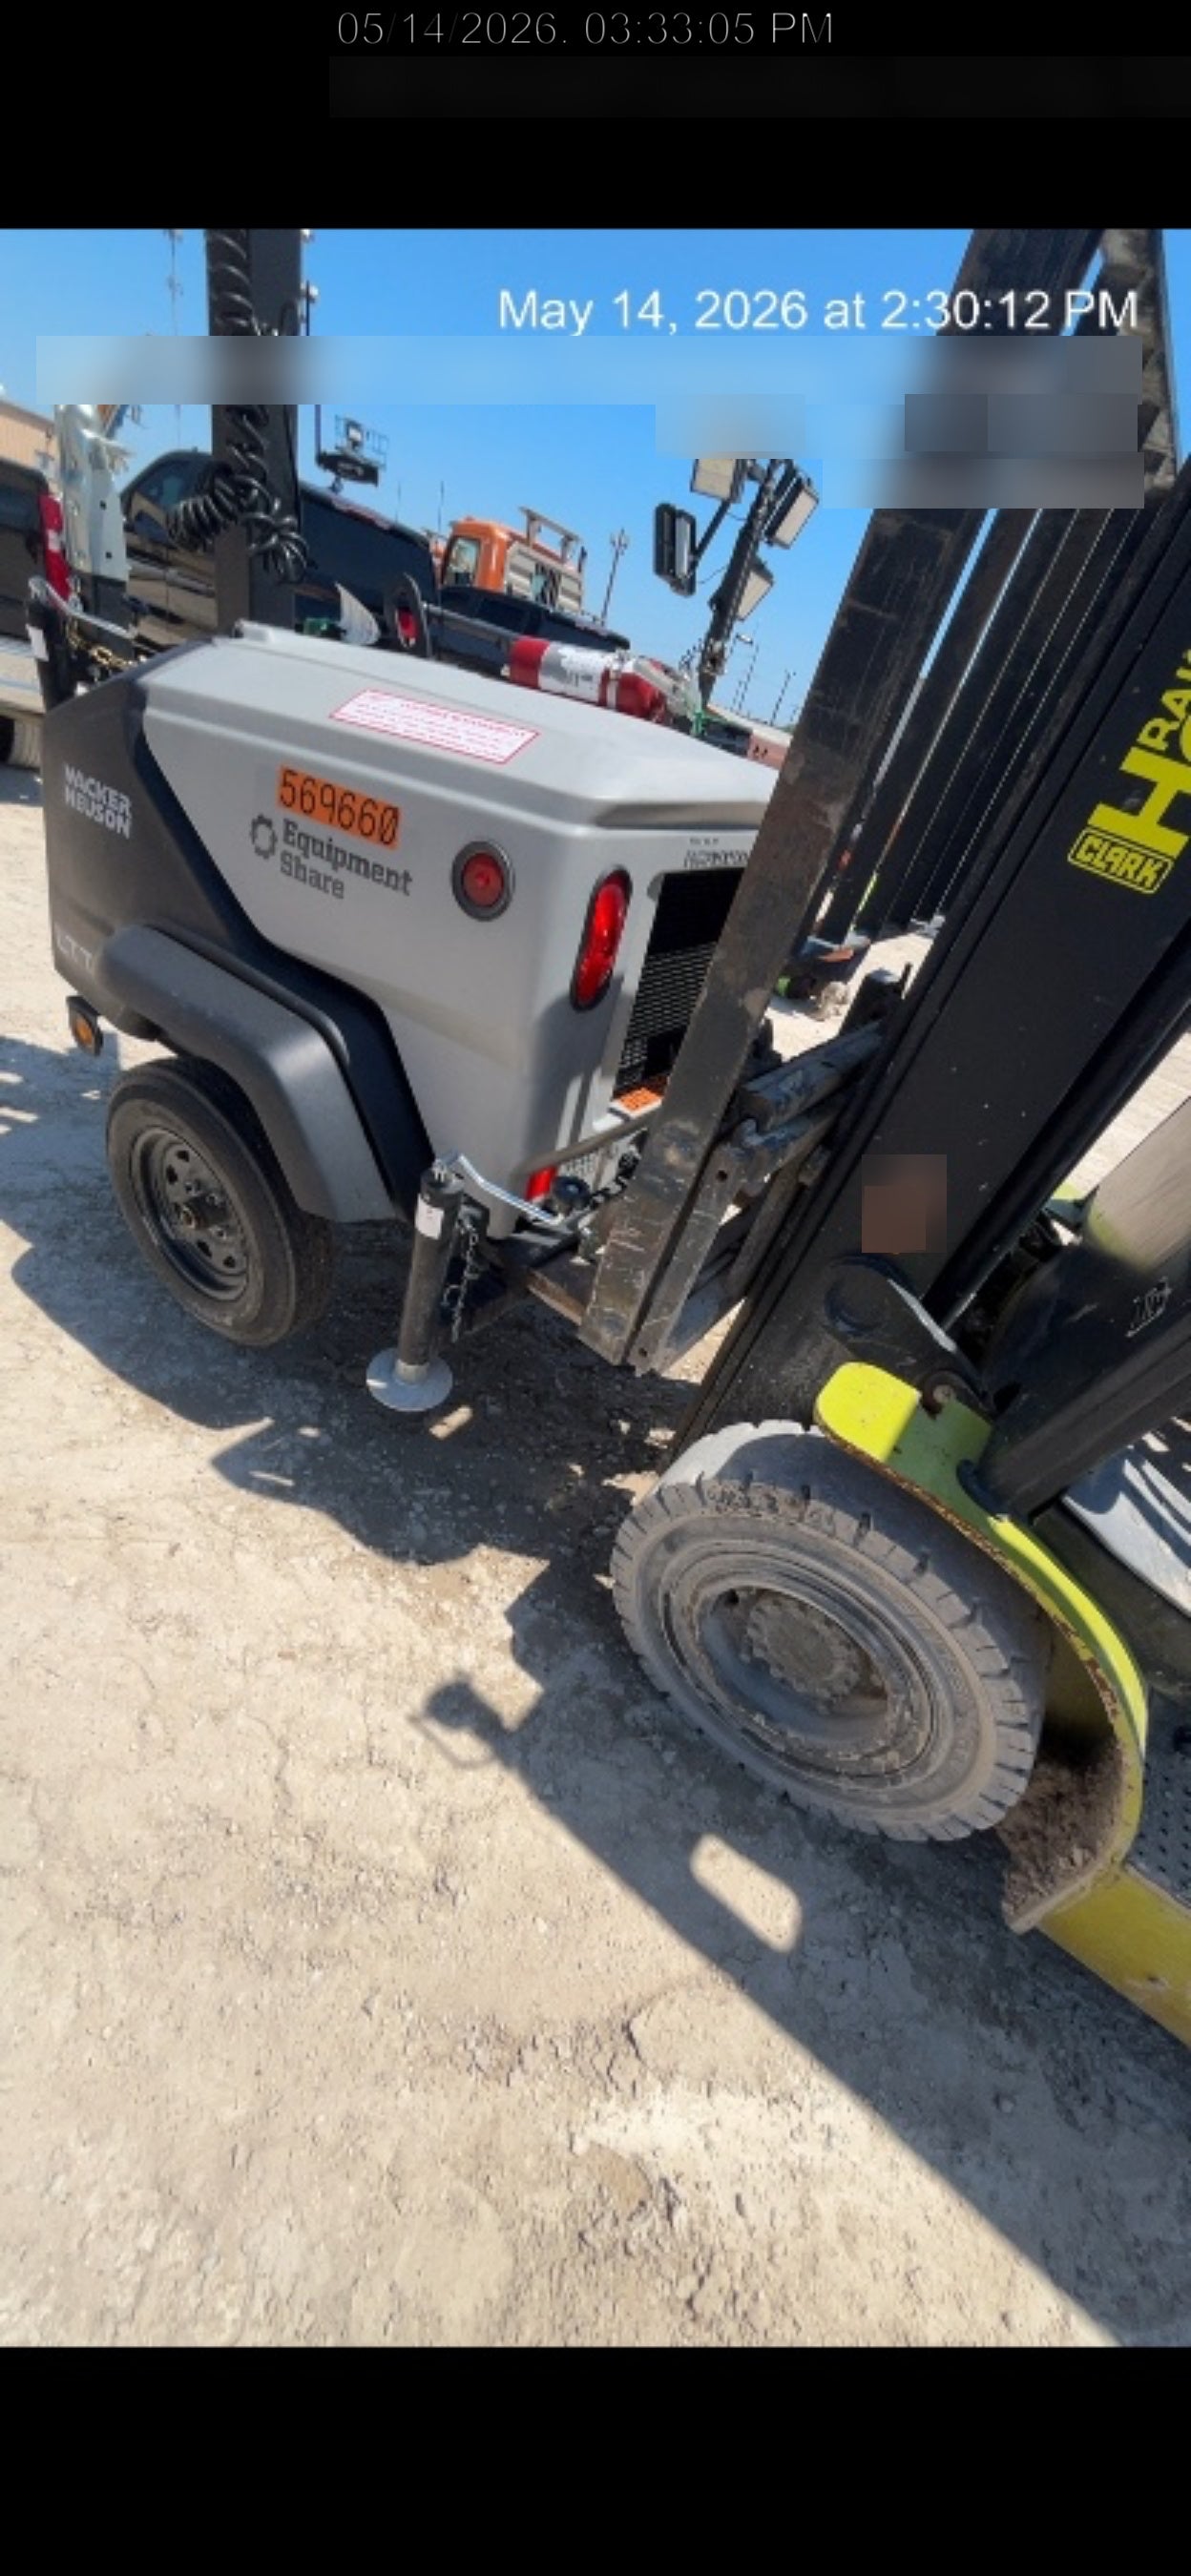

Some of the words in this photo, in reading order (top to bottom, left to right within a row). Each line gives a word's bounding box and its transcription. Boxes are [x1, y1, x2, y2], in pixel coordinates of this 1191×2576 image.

[1137, 648, 1191, 751] RA
[281, 769, 399, 844] 569660
[280, 850, 345, 900] Share
[282, 818, 412, 896] Equipment
[1075, 834, 1163, 889] CLARK
